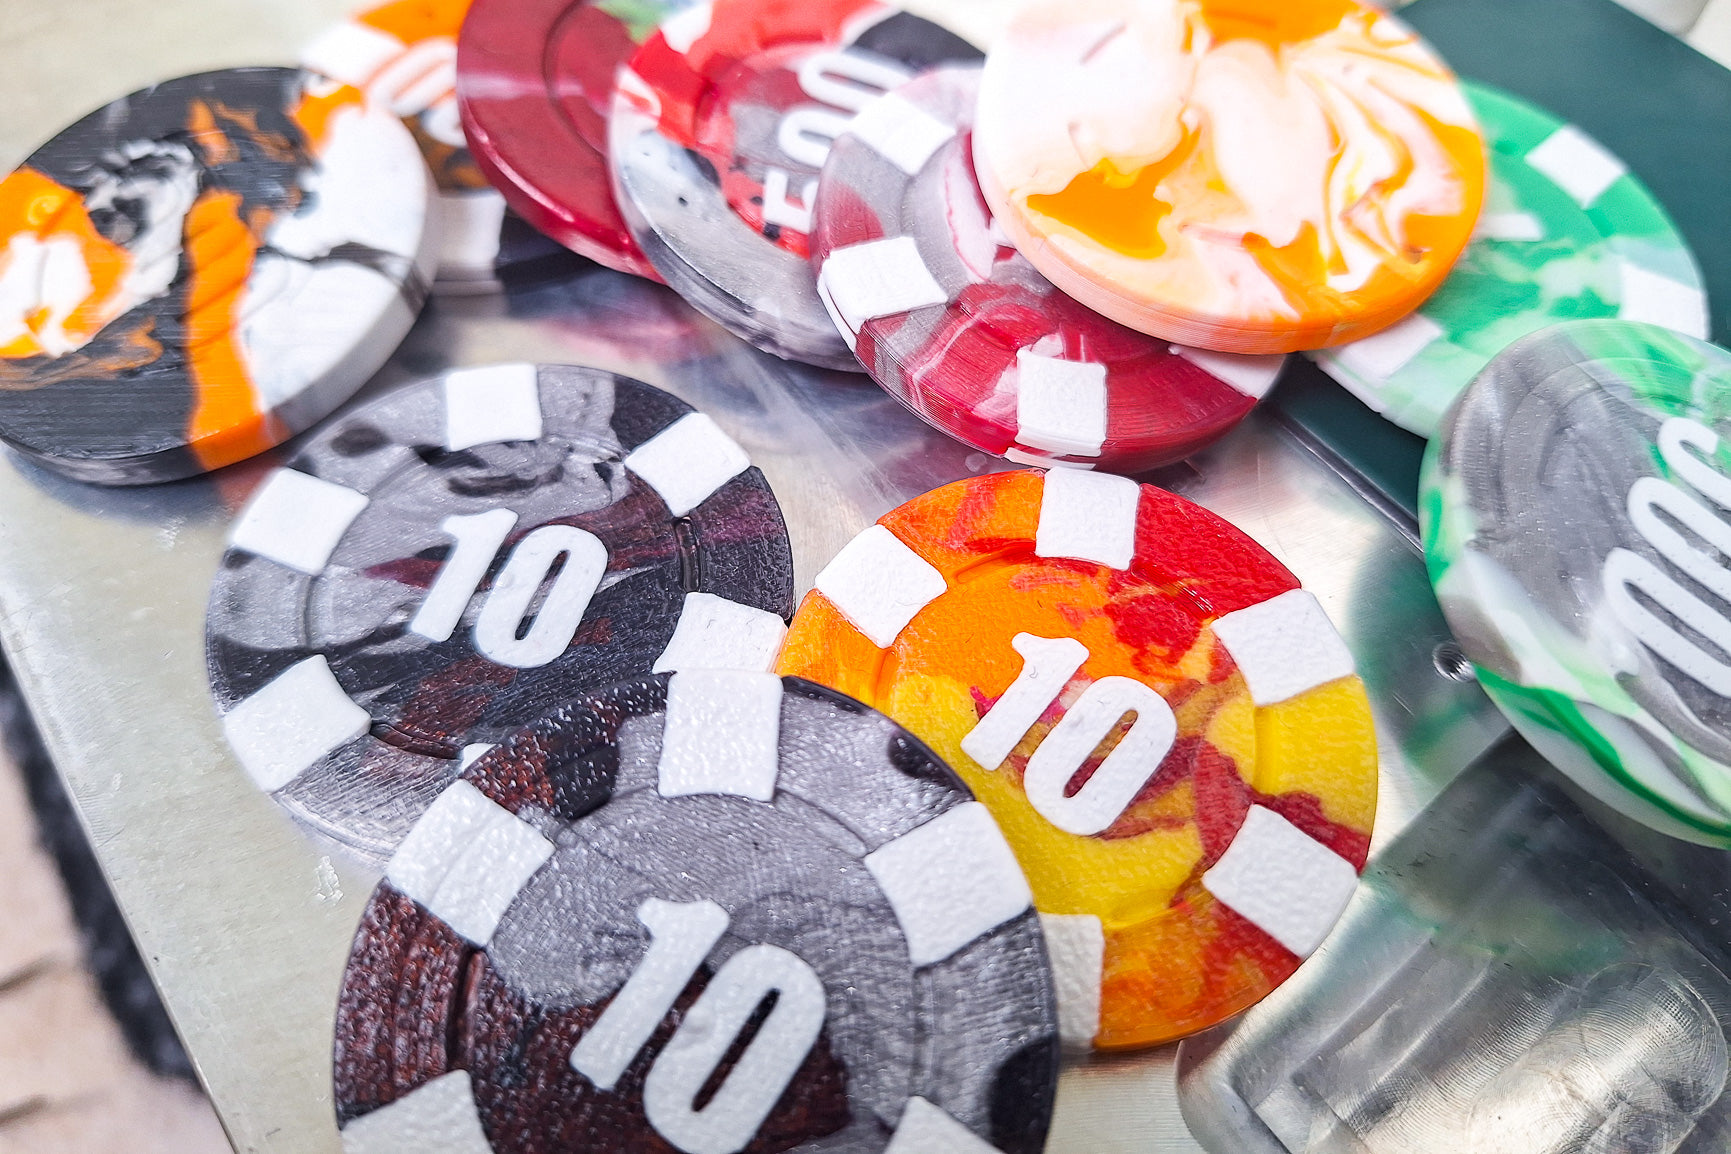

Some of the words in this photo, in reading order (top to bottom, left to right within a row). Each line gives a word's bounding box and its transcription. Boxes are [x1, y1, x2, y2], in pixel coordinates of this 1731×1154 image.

[411, 508, 608, 669] 10
[960, 631, 1177, 836] 10
[569, 899, 826, 1154] 10
